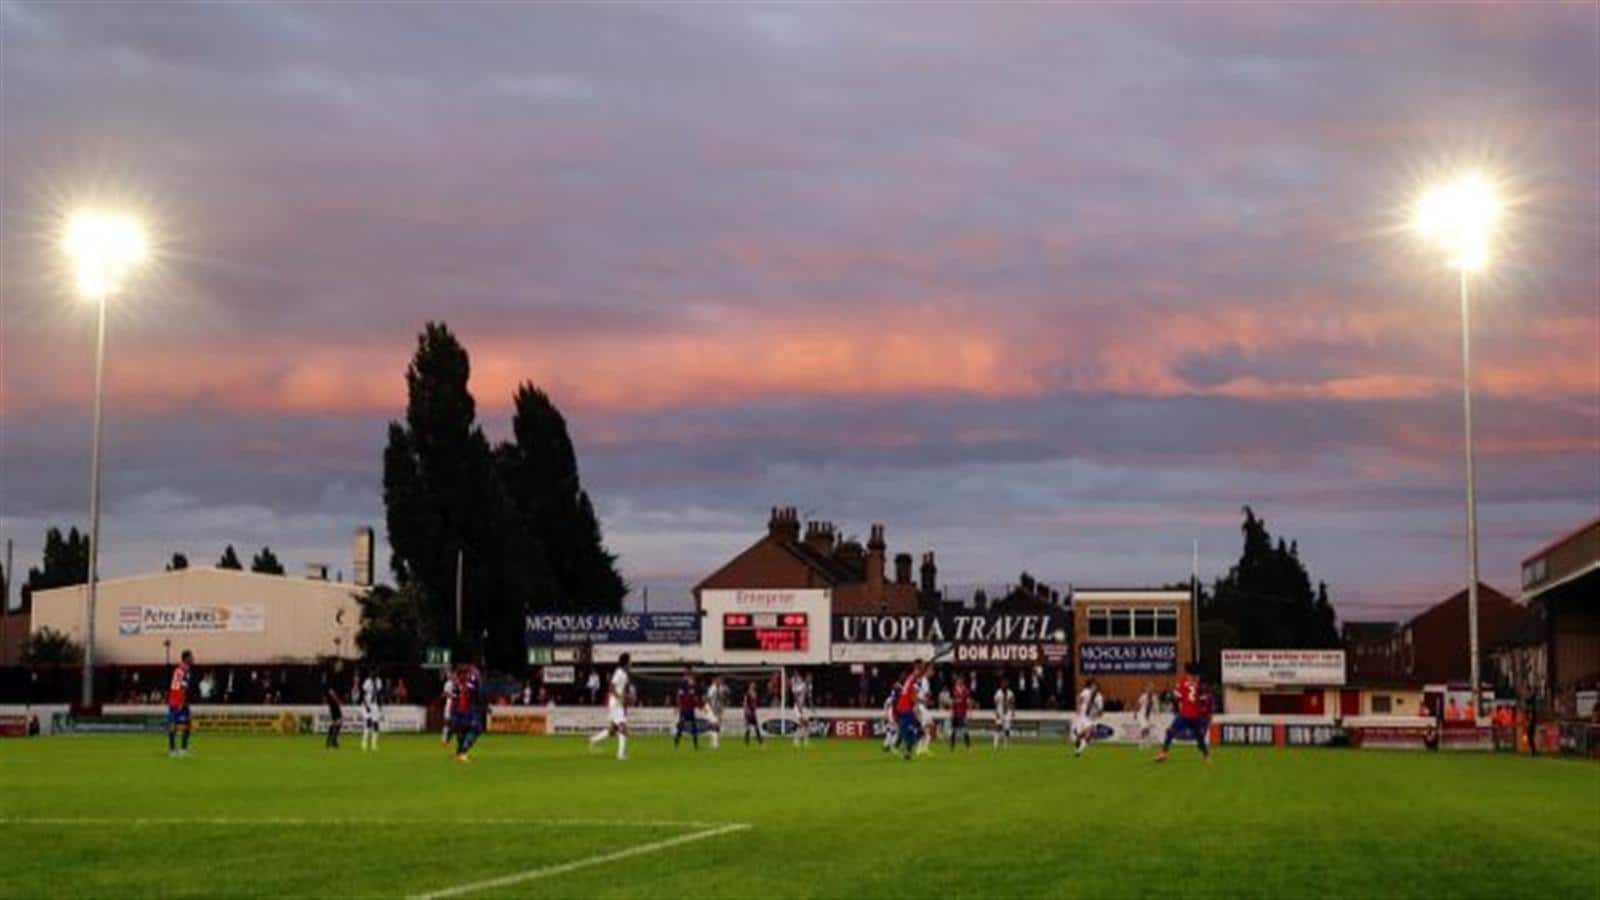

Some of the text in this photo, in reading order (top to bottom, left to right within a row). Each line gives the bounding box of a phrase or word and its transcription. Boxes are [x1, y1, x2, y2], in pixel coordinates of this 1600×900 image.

[525, 614, 593, 631] NICHOLAS
[595, 614, 640, 631] JAMES
[842, 615, 1055, 641] UTOPIA TRAVEL
[958, 644, 987, 660] DON
[991, 644, 1038, 660] AUTOS
[835, 720, 866, 737] BET
